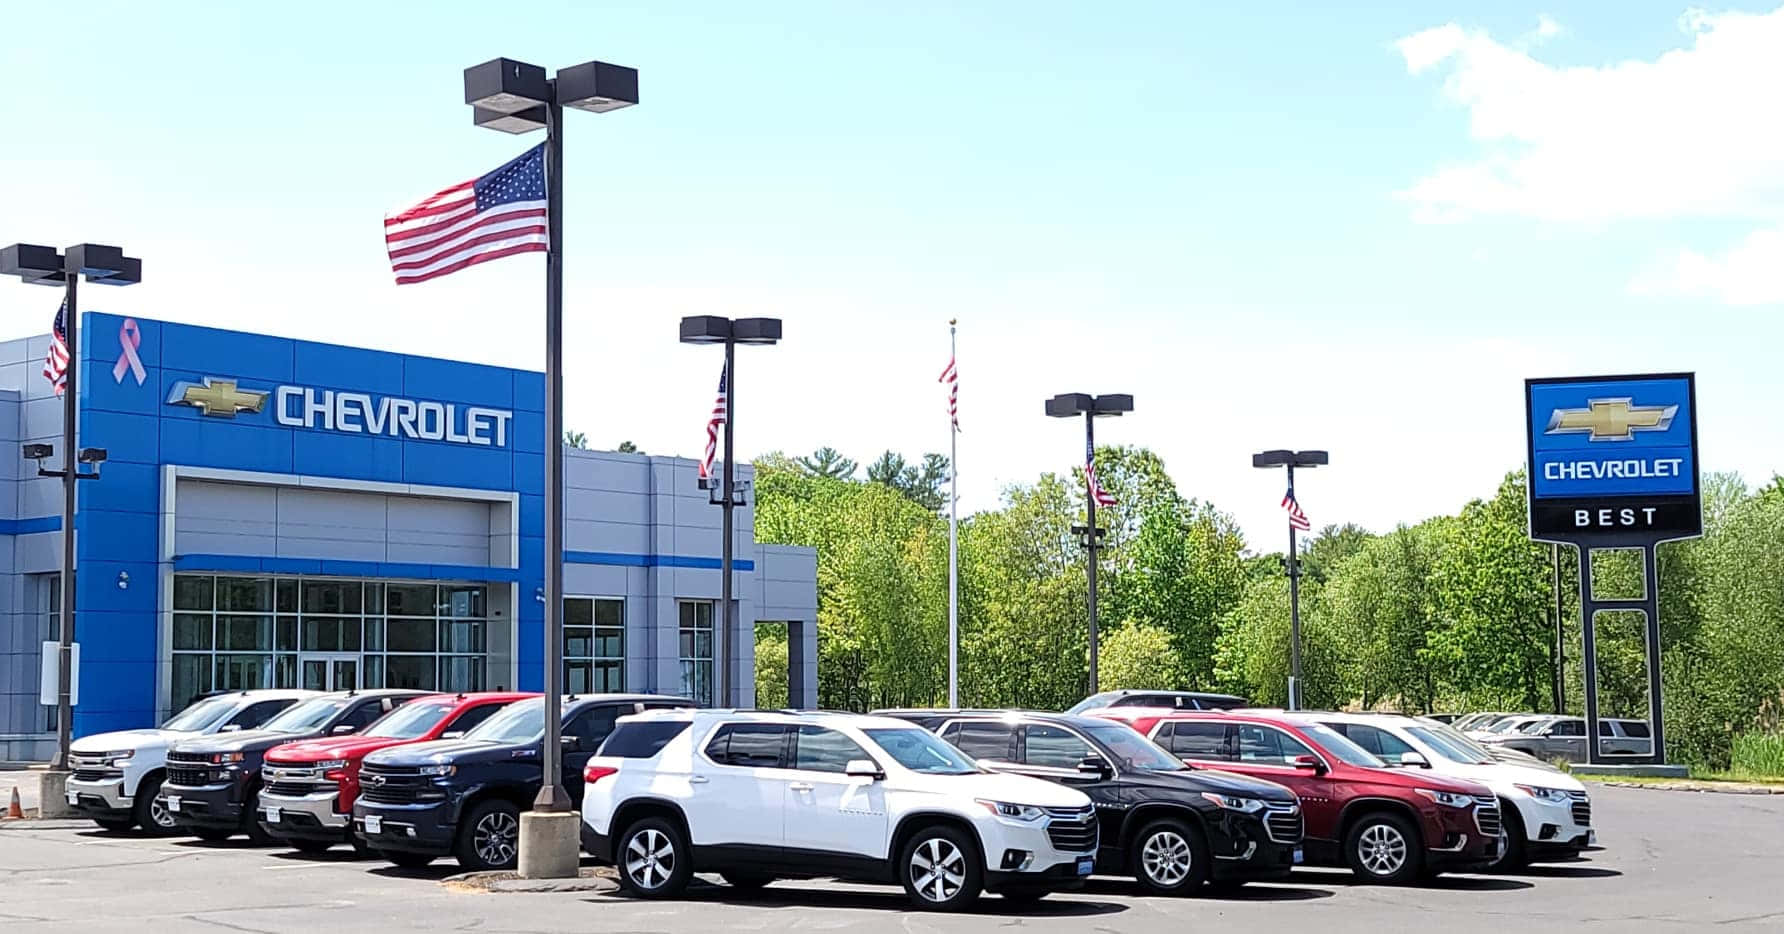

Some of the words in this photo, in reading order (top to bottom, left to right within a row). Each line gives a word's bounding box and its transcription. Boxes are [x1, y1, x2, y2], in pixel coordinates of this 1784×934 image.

[277, 385, 512, 447] CHEVROLET
[1544, 459, 1682, 479] CHEVROLET
[1574, 508, 1657, 526] BEST
